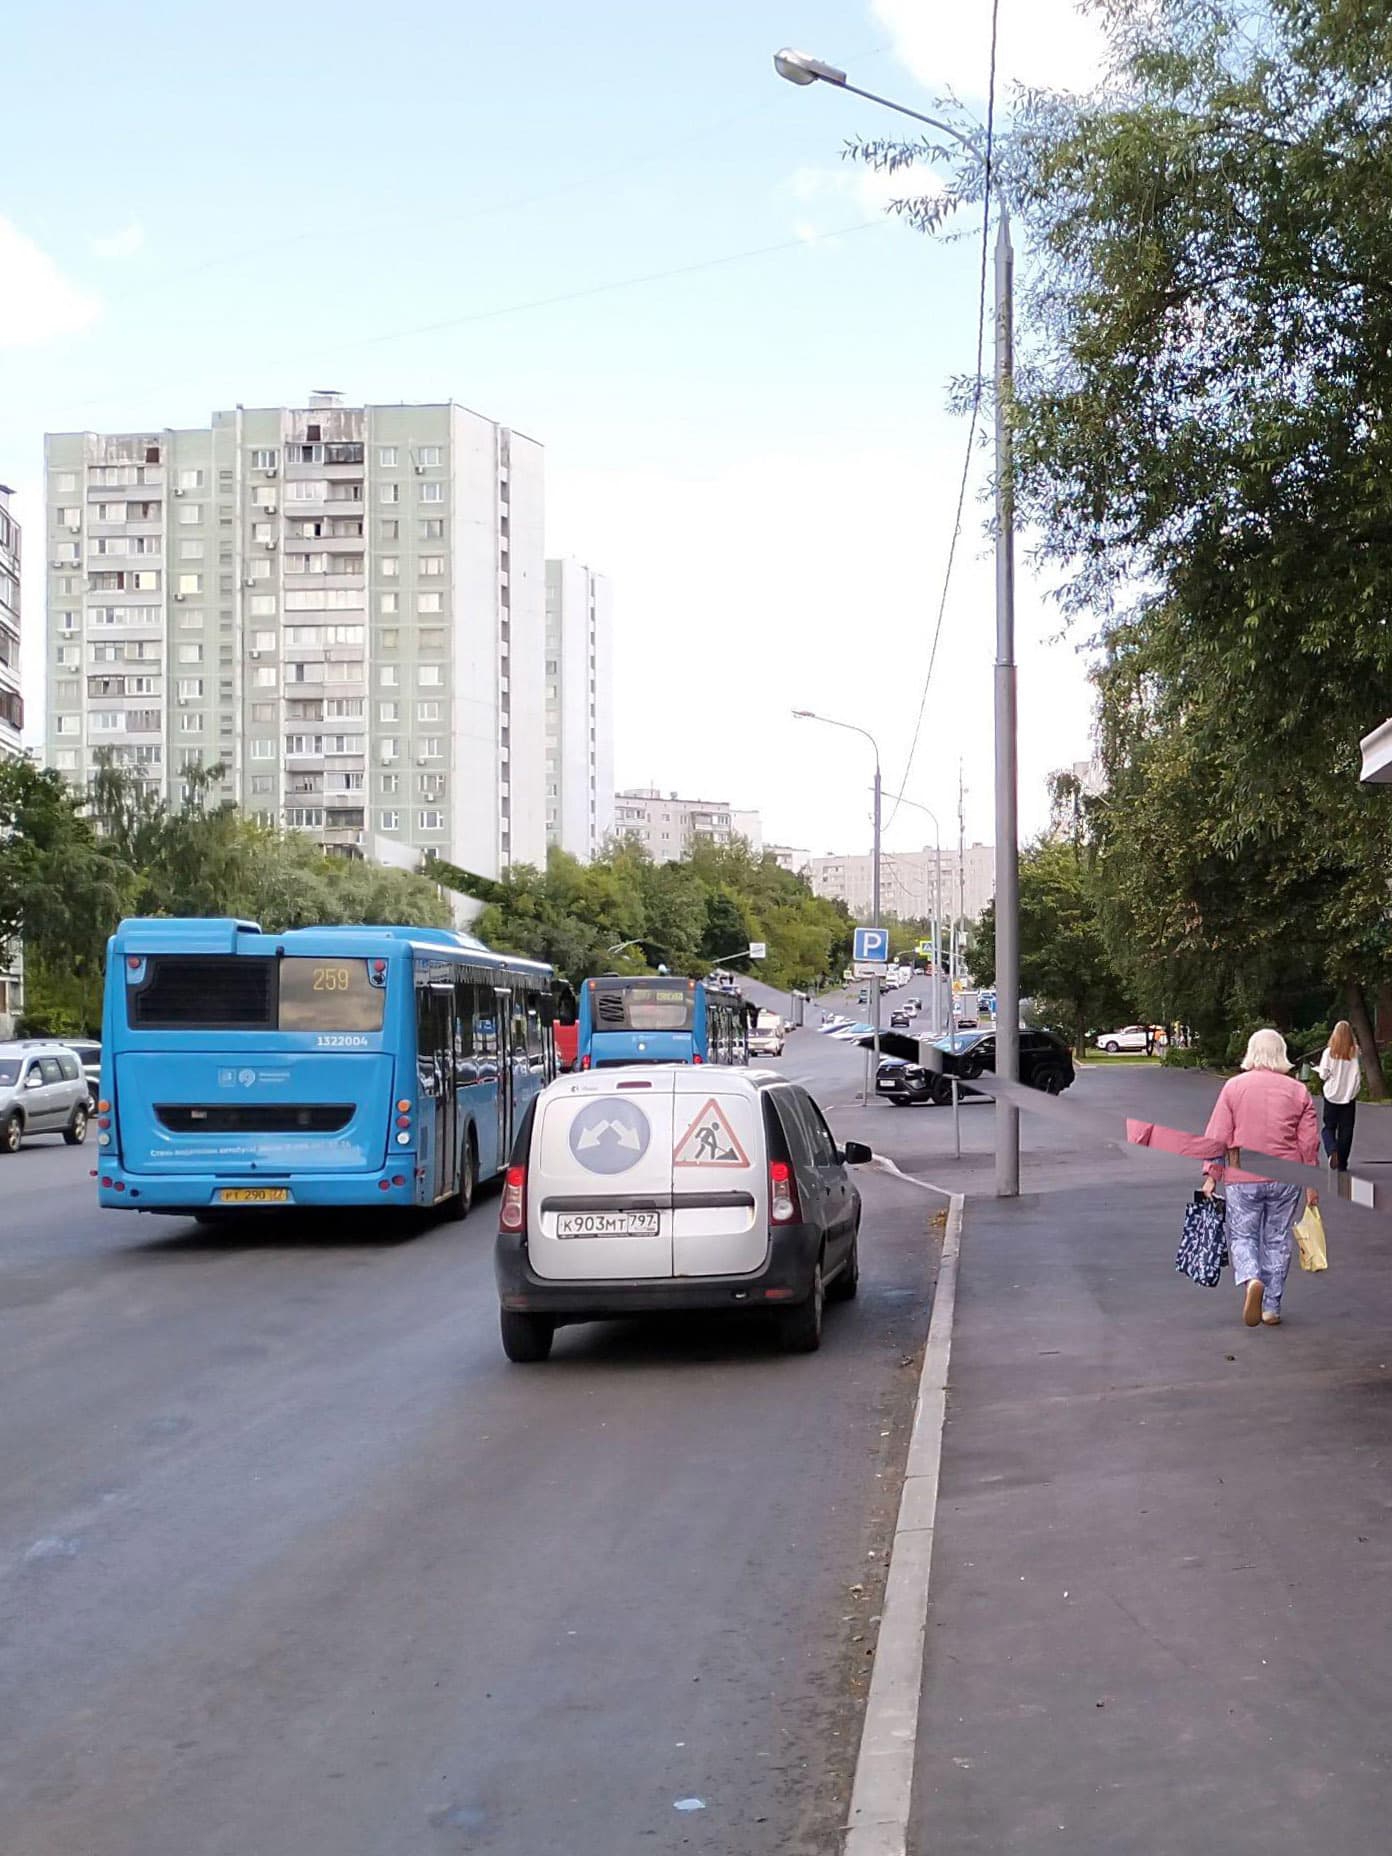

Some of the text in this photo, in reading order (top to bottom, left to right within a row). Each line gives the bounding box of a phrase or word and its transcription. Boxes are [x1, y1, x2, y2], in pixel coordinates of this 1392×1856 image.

[863, 932, 882, 957] P
[312, 968, 350, 991] 259
[317, 1036, 369, 1047] 1322004
[245, 1190, 266, 1200] 290
[563, 1214, 655, 1232] К903МТ 797
